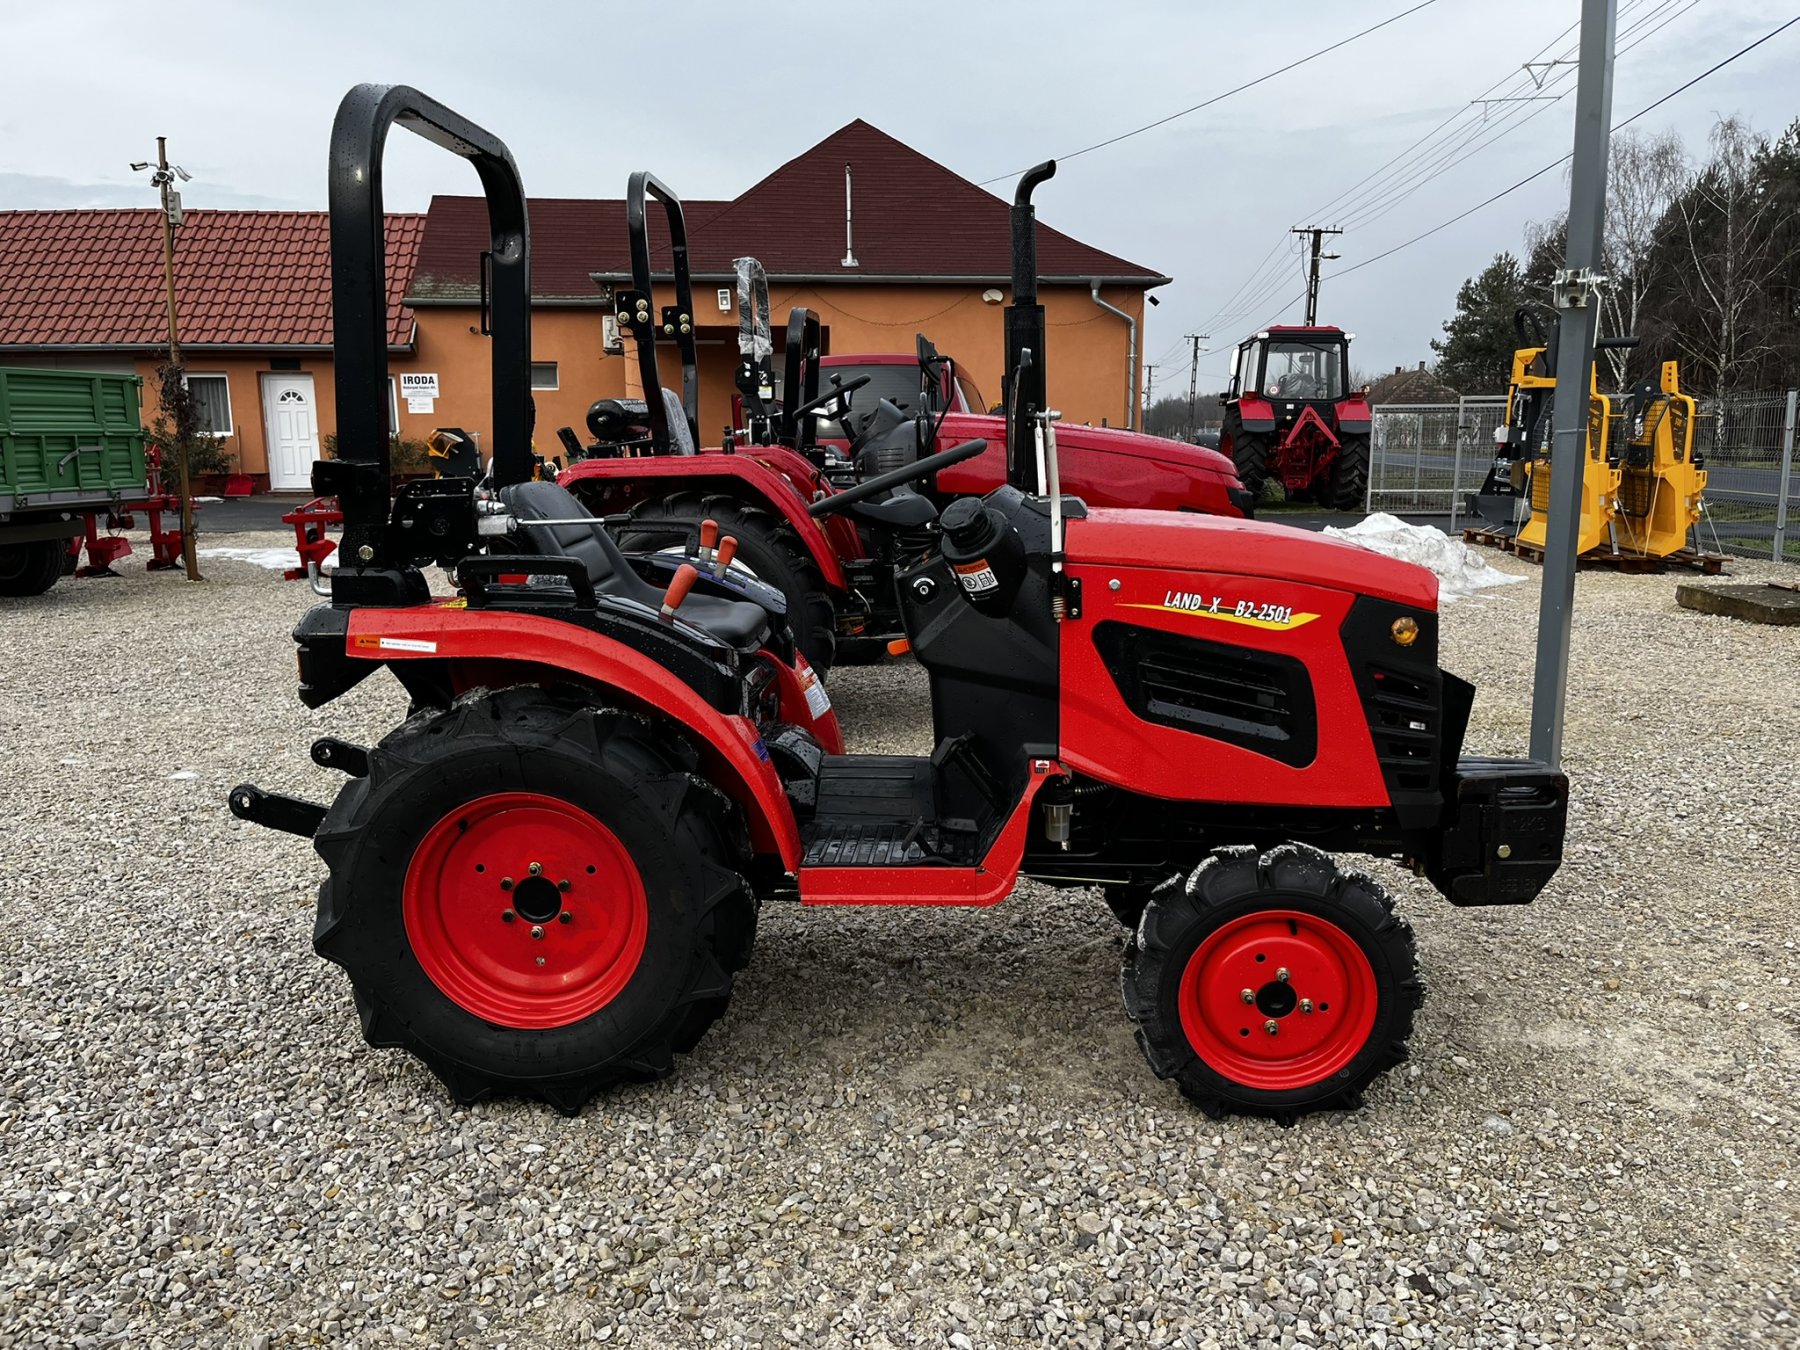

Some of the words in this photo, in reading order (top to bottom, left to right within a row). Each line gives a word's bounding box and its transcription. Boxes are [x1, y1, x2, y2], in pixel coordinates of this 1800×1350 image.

[403, 376, 434, 384] IRODA
[1164, 590, 1201, 611] LAND
[1208, 597, 1222, 614] X
[1234, 600, 1292, 624] B2-2501
